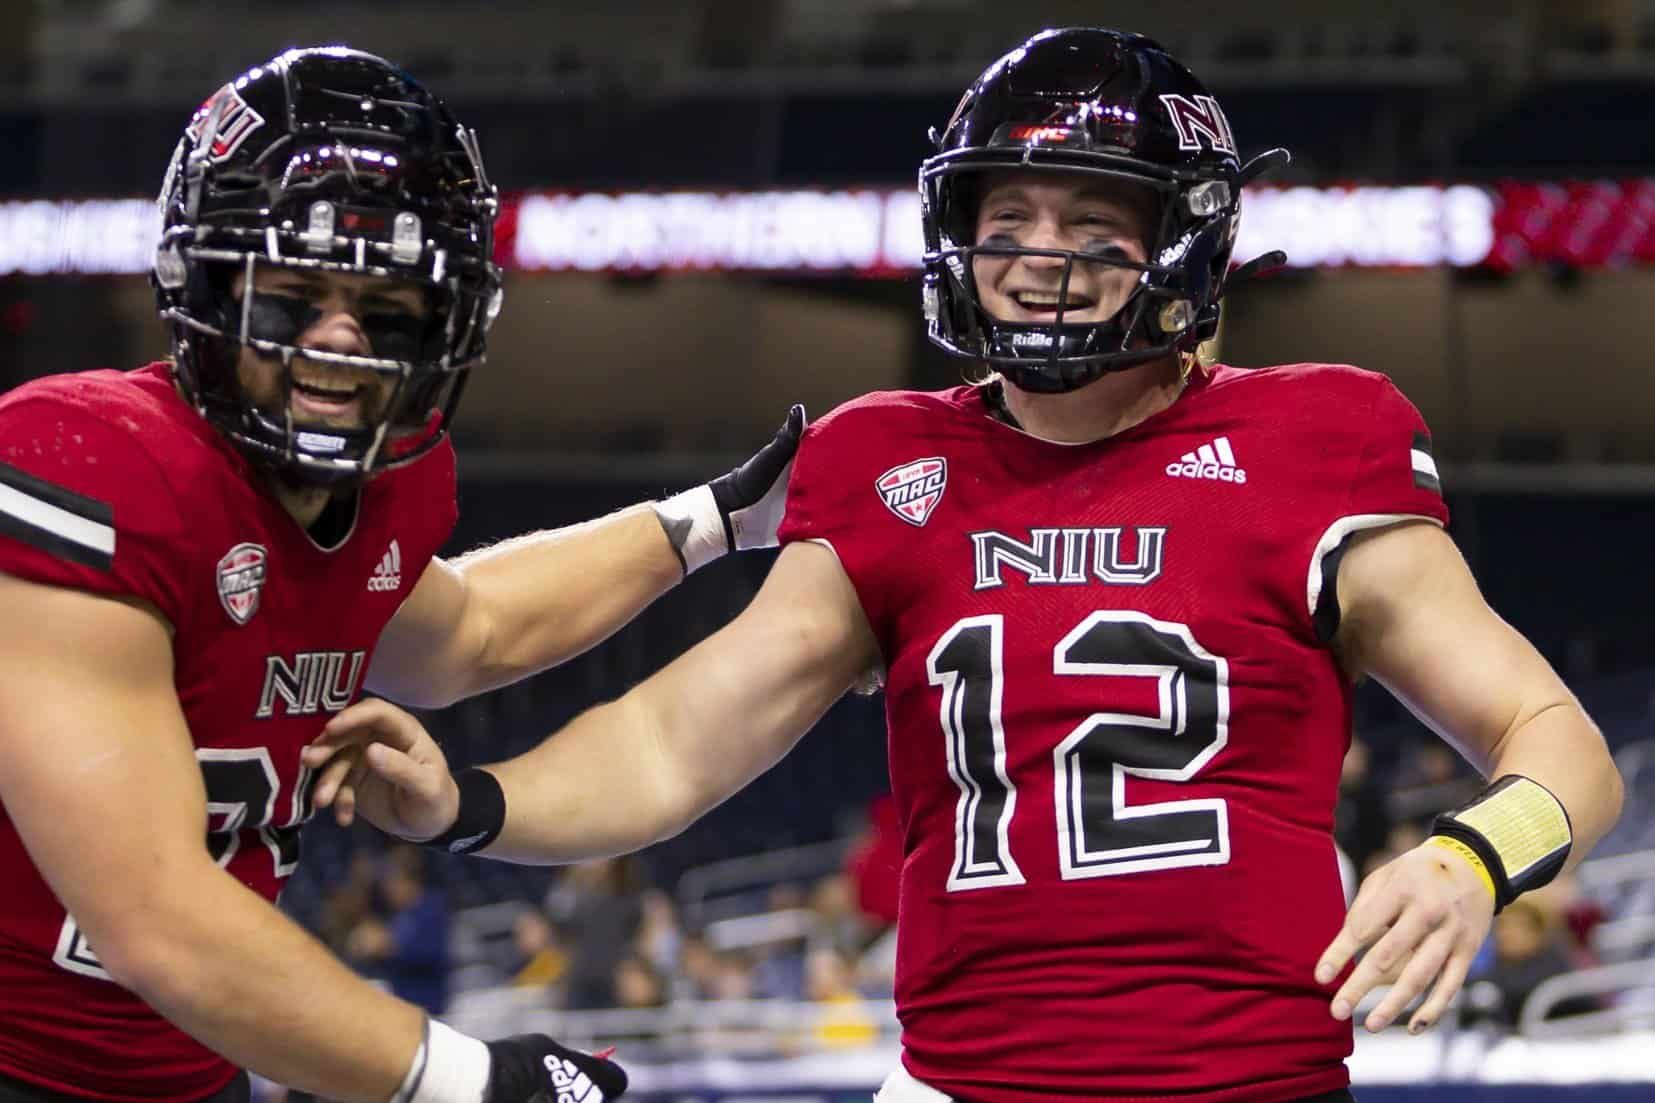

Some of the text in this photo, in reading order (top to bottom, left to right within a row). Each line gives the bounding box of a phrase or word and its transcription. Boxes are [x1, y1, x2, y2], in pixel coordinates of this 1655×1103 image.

[885, 471, 944, 506] MAC
[1164, 461, 1247, 484] adidas
[971, 527, 1167, 590] NIU
[255, 651, 366, 718] NIU
[926, 609, 1231, 892] 12
